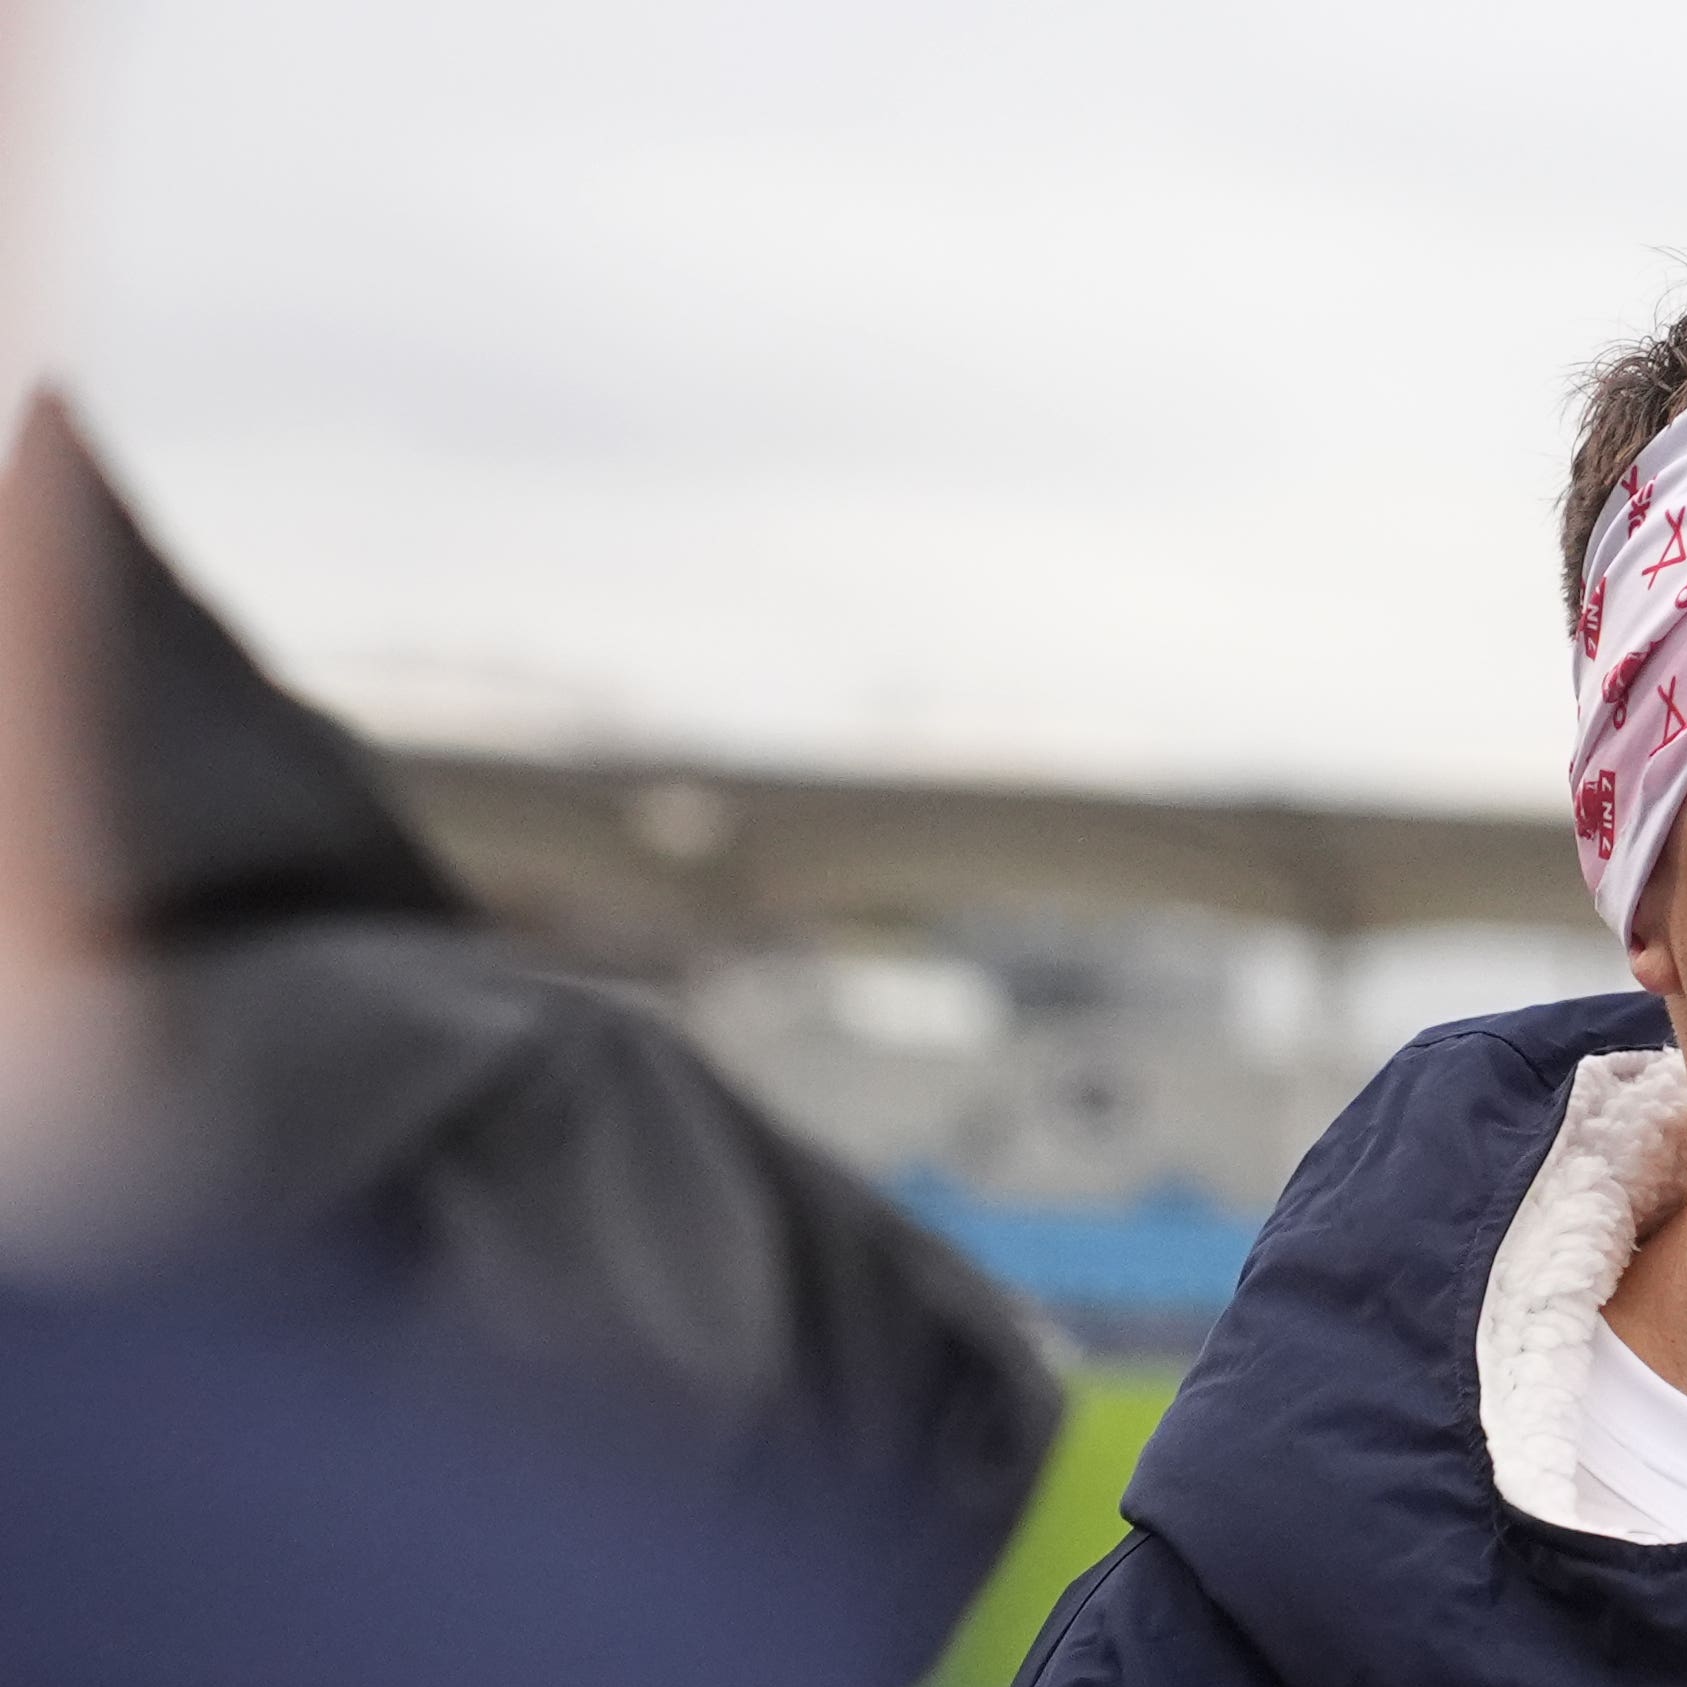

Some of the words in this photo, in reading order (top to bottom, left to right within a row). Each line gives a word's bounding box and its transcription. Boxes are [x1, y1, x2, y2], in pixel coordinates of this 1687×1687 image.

[1585, 604, 1600, 631] IN
[1601, 776, 1612, 792] 7
[1601, 801, 1613, 829] IN
